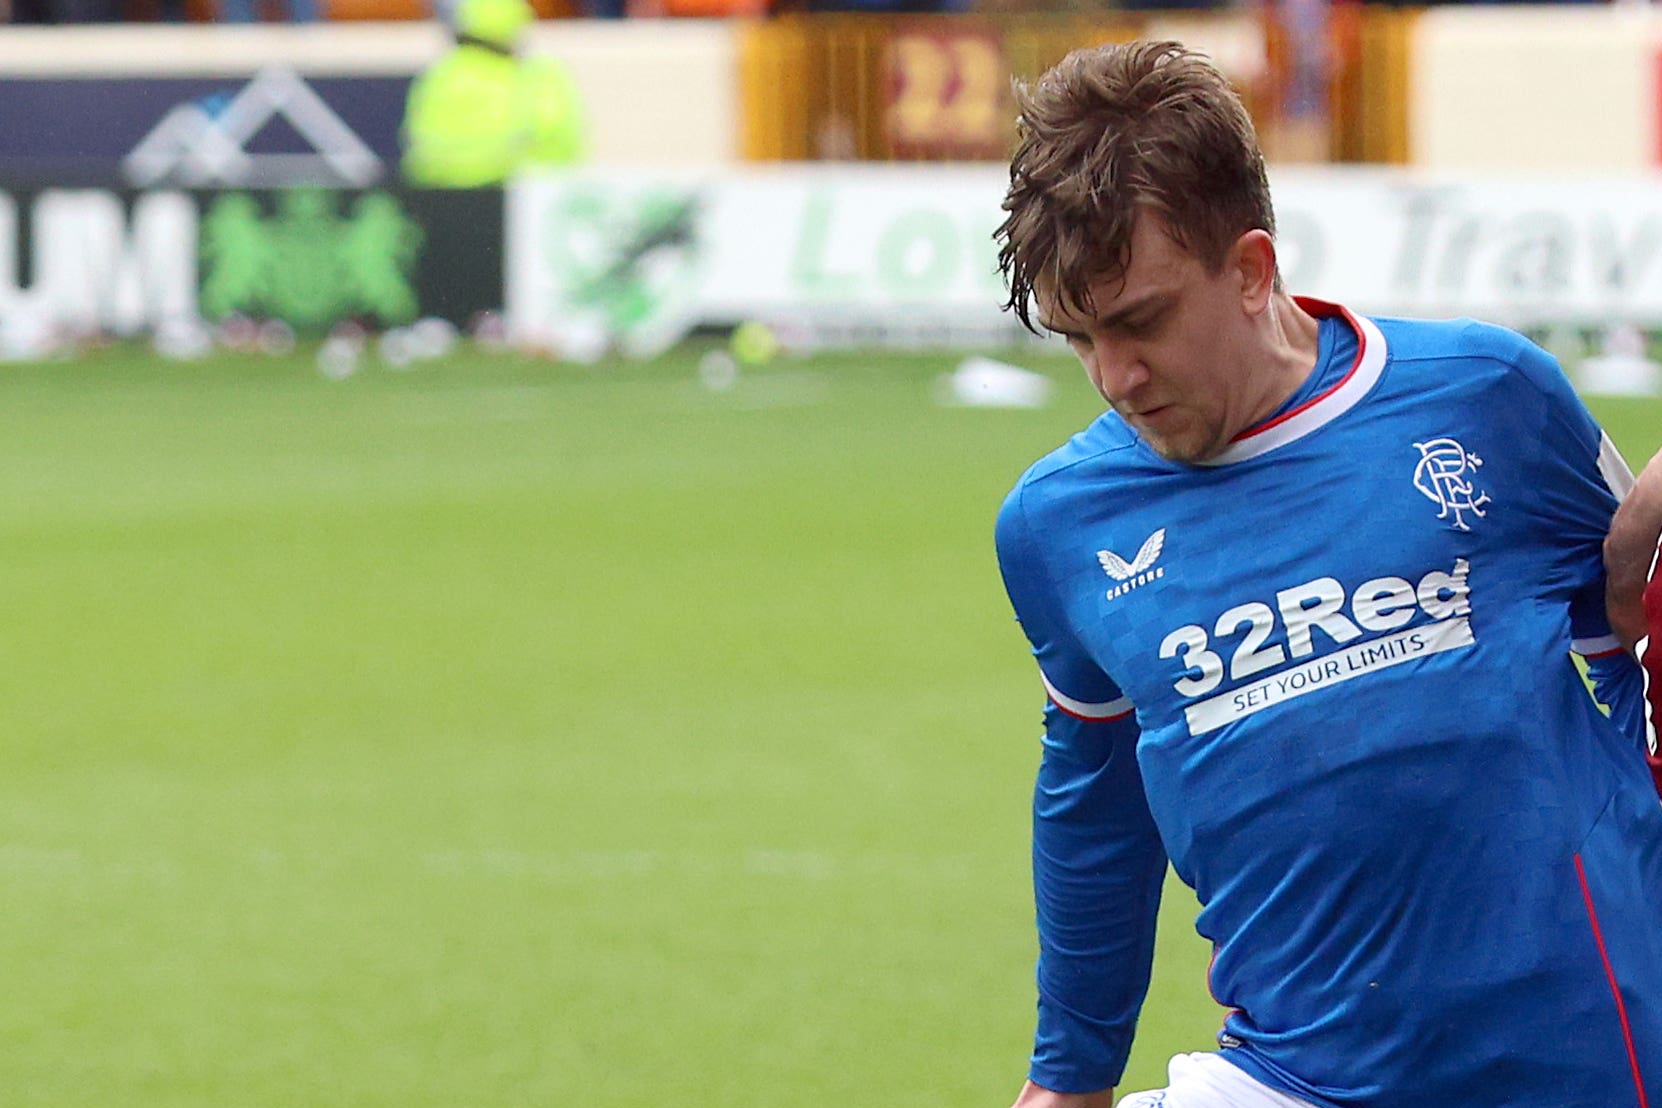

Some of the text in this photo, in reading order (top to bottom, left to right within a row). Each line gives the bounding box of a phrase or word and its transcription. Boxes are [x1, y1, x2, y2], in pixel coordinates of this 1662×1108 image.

[1105, 567, 1165, 602] CASTORE
[1158, 558, 1473, 699] 32Red
[1233, 633, 1425, 712] SET YOUR LIMITS
